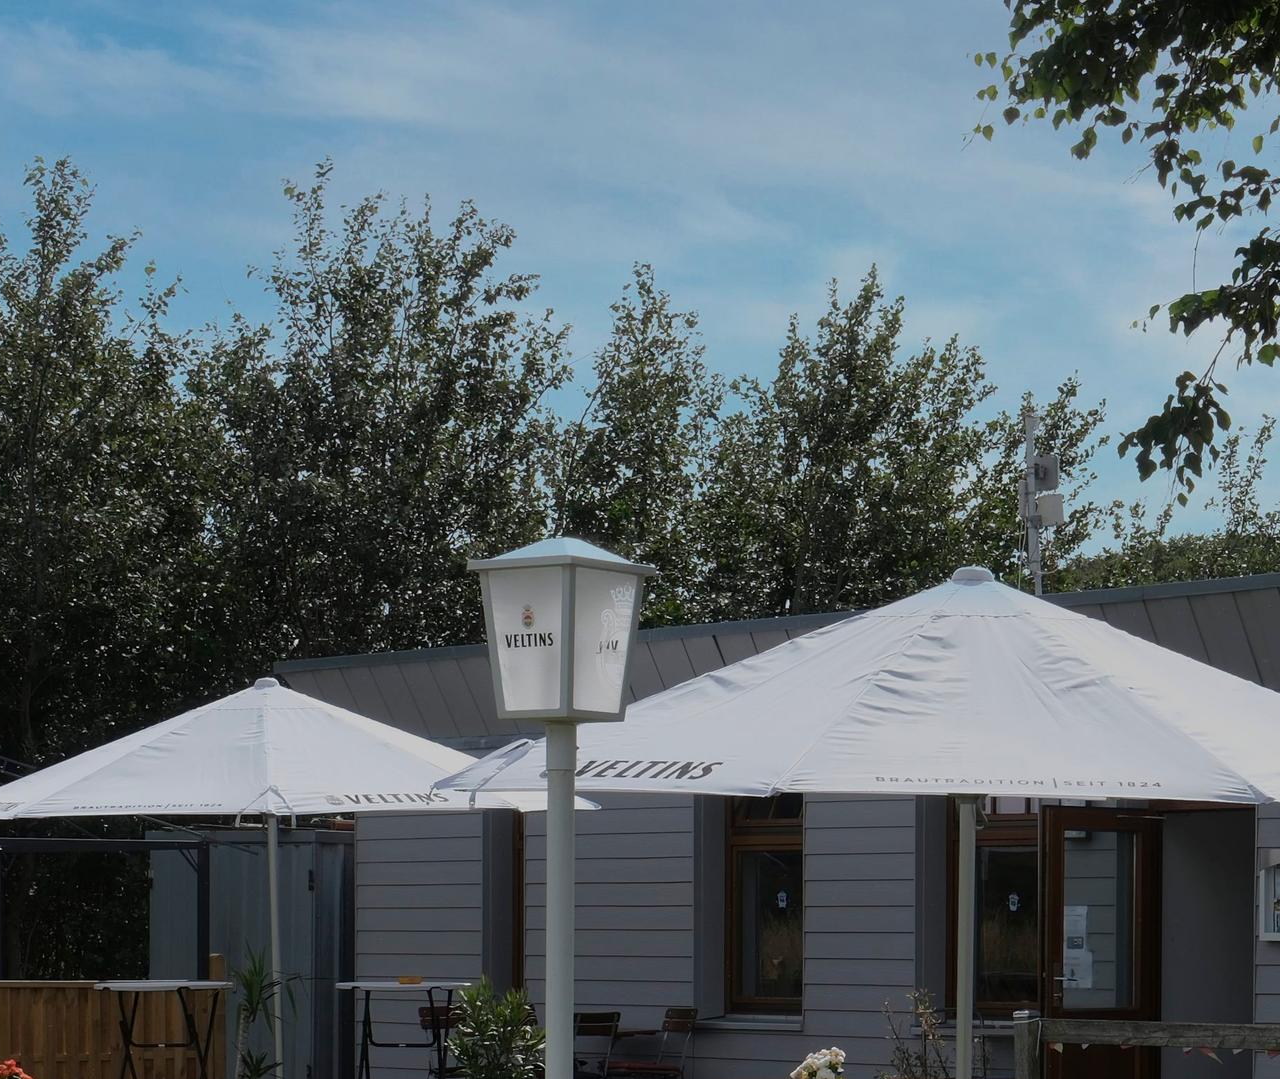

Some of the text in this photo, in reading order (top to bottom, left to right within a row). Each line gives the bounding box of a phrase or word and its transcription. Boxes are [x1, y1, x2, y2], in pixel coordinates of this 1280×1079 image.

[505, 632, 553, 648] VELTINS
[575, 760, 723, 780] VELTINS
[875, 776, 1044, 787] BRAUTRADITION
[1063, 780, 1103, 788] SEIT
[343, 792, 449, 806] VELTINS
